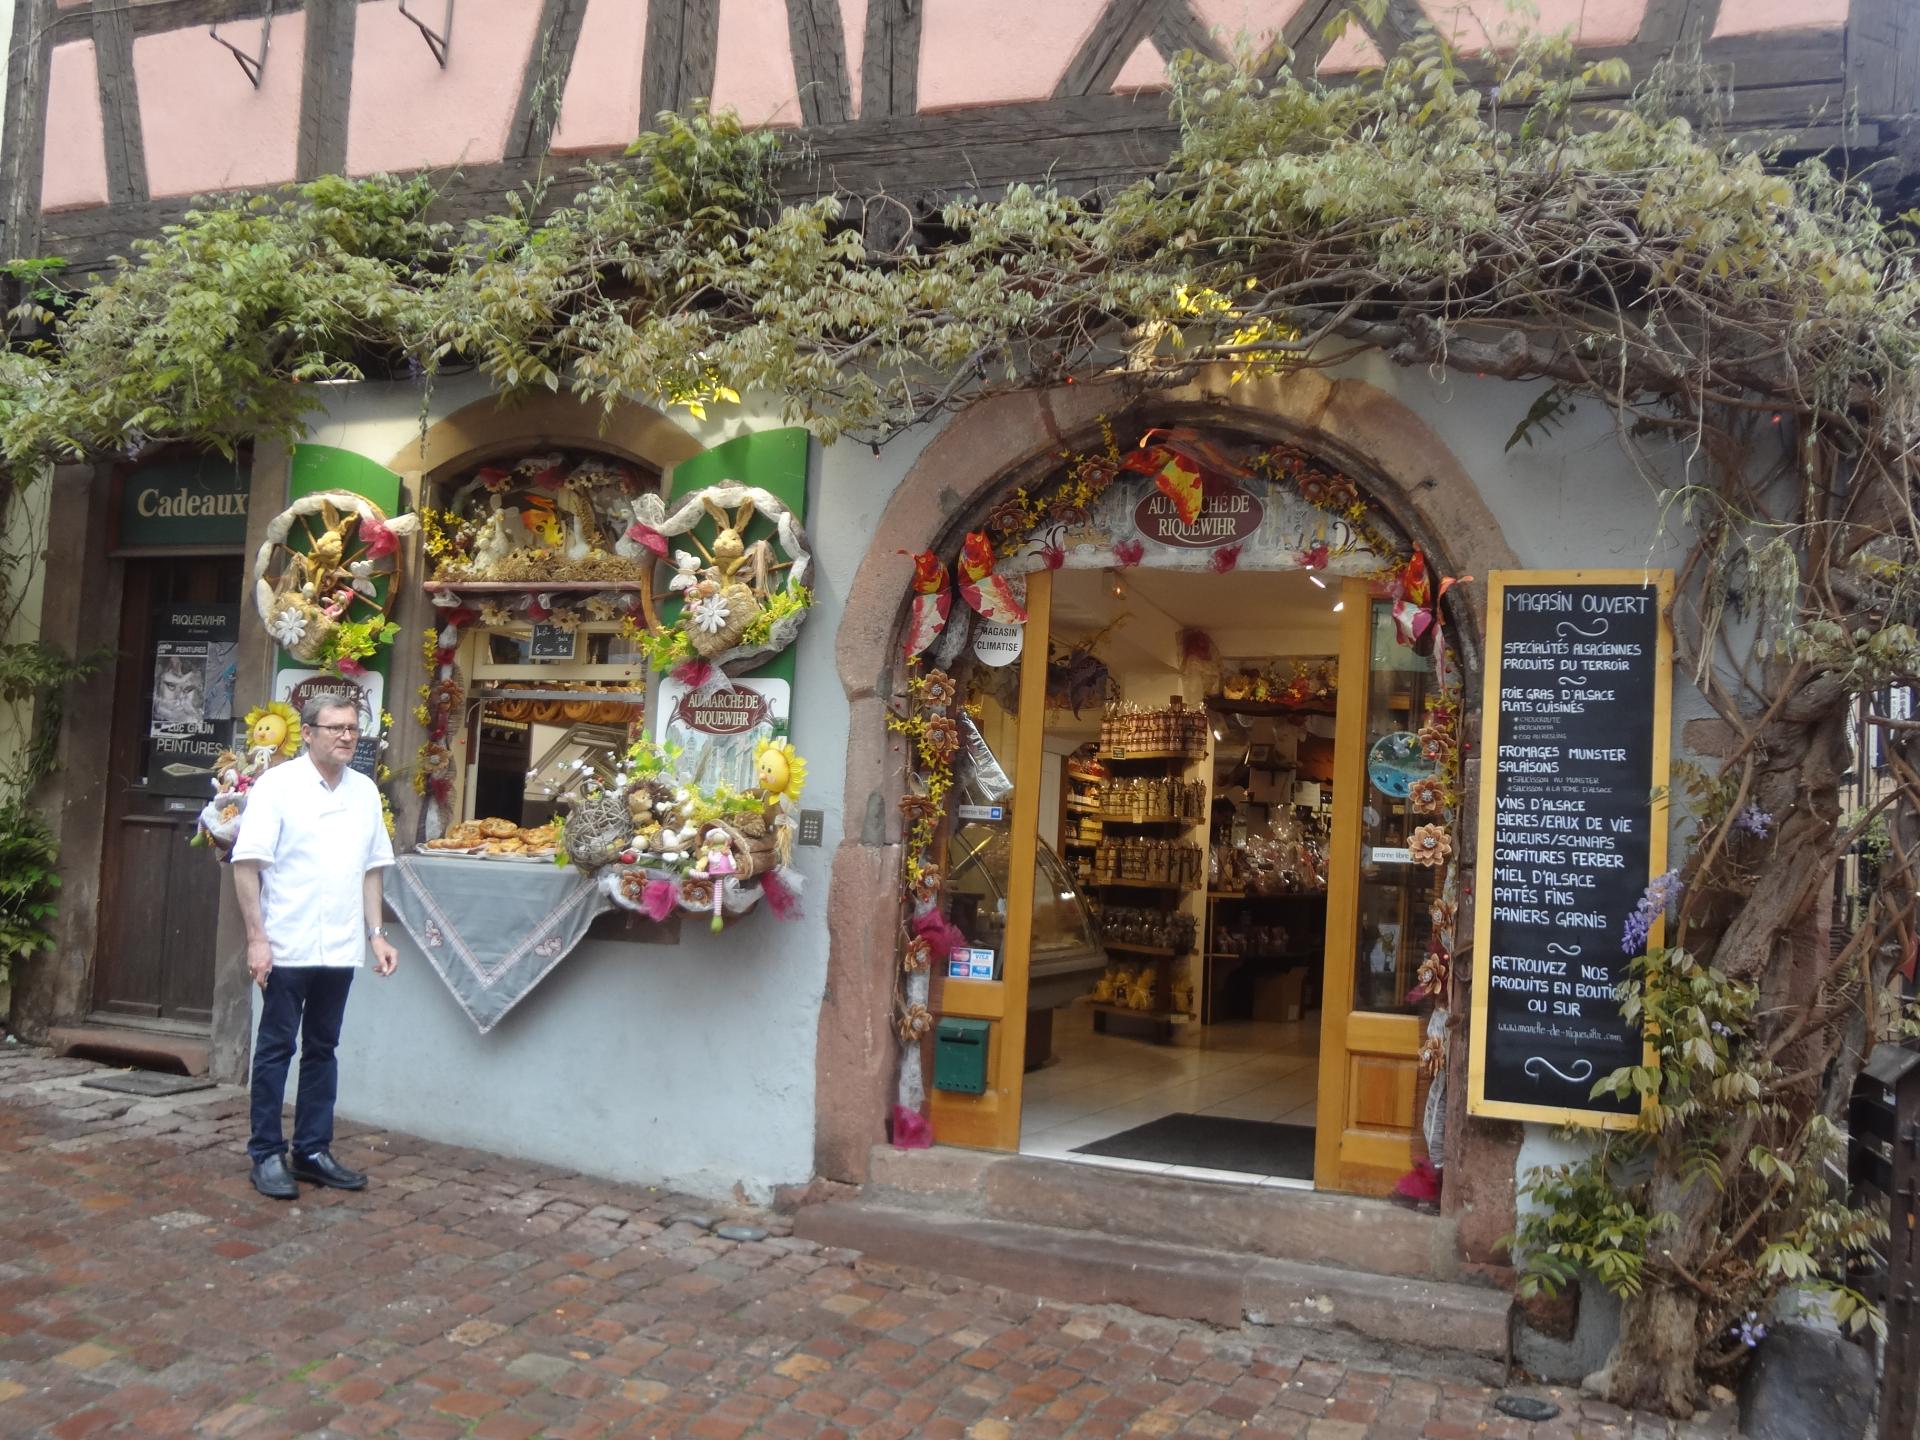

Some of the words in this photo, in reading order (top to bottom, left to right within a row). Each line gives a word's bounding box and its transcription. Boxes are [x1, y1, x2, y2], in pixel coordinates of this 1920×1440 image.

[137, 488, 248, 517] Cadeaux
[1148, 496, 1167, 514] AU
[1169, 492, 1228, 514] MCHÉ
[1230, 495, 1250, 513] DE
[1158, 517, 1237, 538] RIQUEWIHR
[1506, 590, 1573, 613] MAGASIN
[1581, 593, 1650, 614] OUVERT
[172, 614, 226, 626] RIQUEWIHR
[982, 627, 1018, 637] MAGASIN
[976, 641, 1019, 652] CLIMATISE
[1573, 641, 1642, 656] ALSACIENNES
[1503, 656, 1555, 670] PRODUITS
[1560, 659, 1578, 671] DU
[1580, 658, 1630, 671] TERROIR
[299, 684, 310, 698] AU
[346, 686, 358, 699] DE
[704, 691, 744, 709] MARCHÉ
[745, 695, 759, 709] DE
[1501, 686, 1523, 699] FOIE
[1526, 689, 1554, 700] GRAS
[1562, 689, 1616, 701] D'ALSACE
[1501, 700, 1533, 712] PLATS
[1536, 700, 1585, 713] CUISINÉS
[695, 710, 749, 729] RIQUEWIHR
[156, 738, 224, 756] PEINTURES
[1498, 745, 1560, 759] FROMAGES
[1568, 748, 1627, 762] MUNSTER
[1498, 759, 1560, 773] SALAISONS
[1565, 776, 1600, 784] MUNSTER
[1496, 794, 1525, 810] VINS
[1531, 798, 1586, 811] D'ALSACE
[1496, 811, 1580, 830] BIERES/EAUX
[1586, 817, 1603, 830] DE
[1610, 816, 1633, 832] VIE
[1496, 828, 1615, 849] LIQUEURS/SCHNAPS
[1495, 848, 1566, 864] CONFITURES
[1572, 852, 1625, 868] FERBER
[1494, 865, 1527, 882] MIEL
[1532, 870, 1596, 888] D'ALSACE
[1494, 885, 1538, 903] PATÉS
[1544, 888, 1575, 905] FINS
[1493, 905, 1550, 925] PANIERS
[1556, 910, 1607, 928] GARNIS
[1492, 955, 1567, 975] RETROUVEZ
[1581, 965, 1609, 980] NOS
[1492, 975, 1549, 993] PRODUITS
[1553, 981, 1571, 995] EN
[1528, 999, 1547, 1013] OU
[1553, 1000, 1581, 1017] SUR
